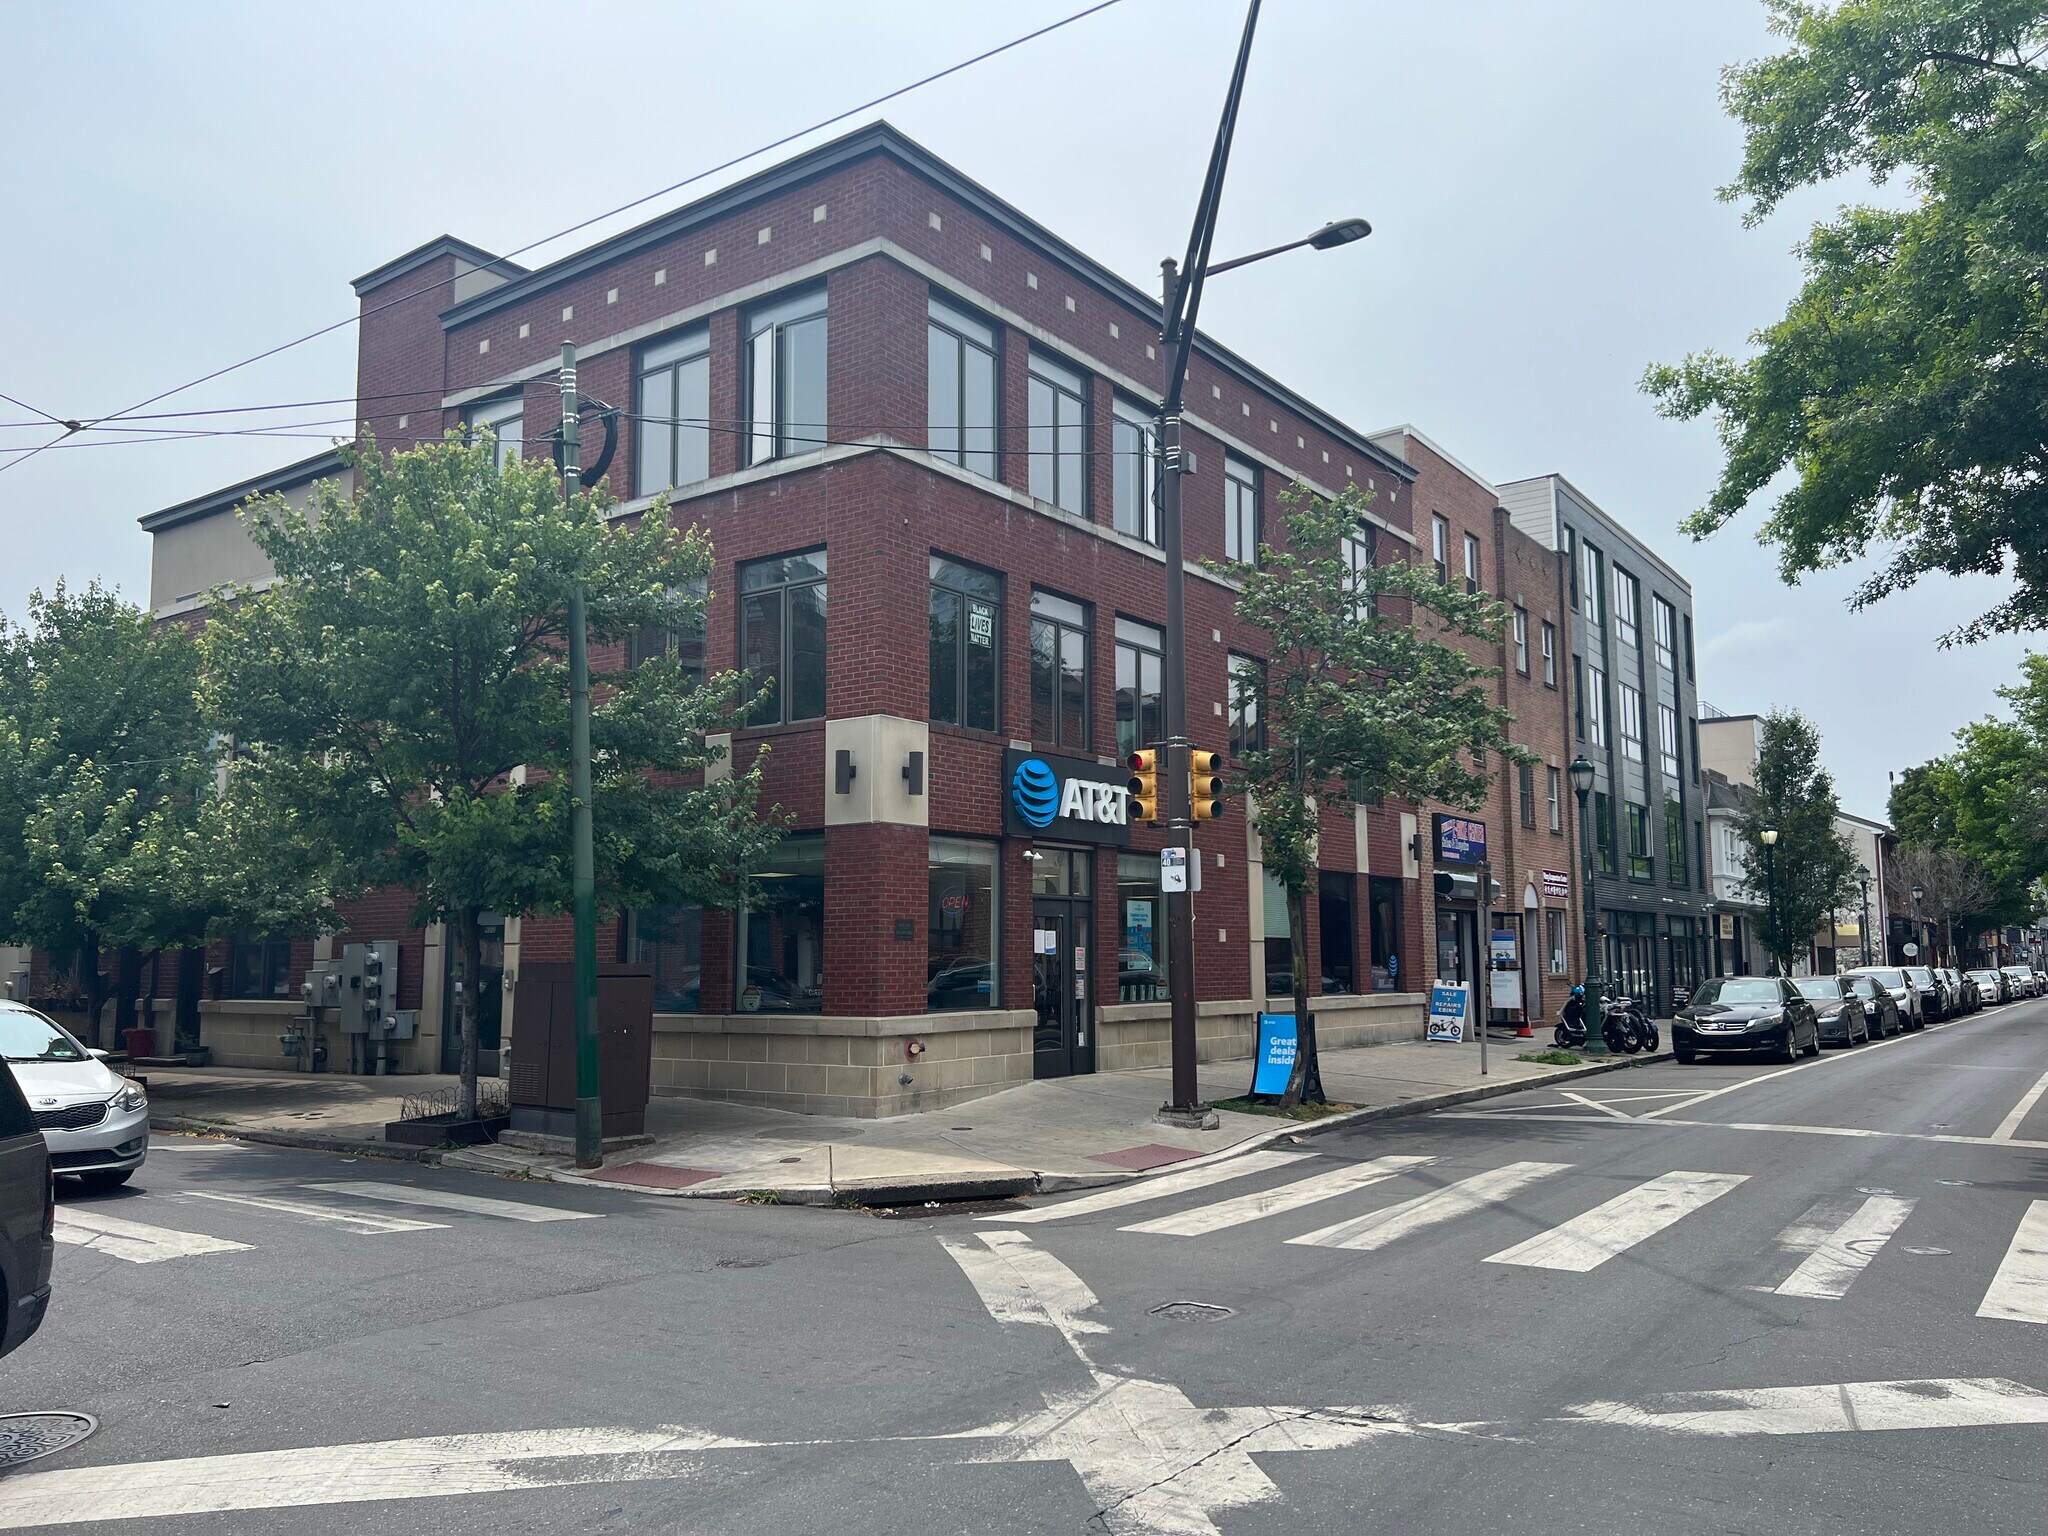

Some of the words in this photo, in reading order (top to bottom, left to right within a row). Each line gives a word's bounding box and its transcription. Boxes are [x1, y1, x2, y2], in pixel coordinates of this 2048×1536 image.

[972, 603, 989, 617] BLACK
[971, 616, 989, 633] LIVES
[970, 632, 990, 646] MATTER
[1059, 777, 1131, 826] AT&T
[1162, 858, 1171, 867] 40
[942, 896, 969, 910] OPEN
[1435, 1001, 1461, 1009] REPAIRS
[1270, 1036, 1297, 1046] Great
[1270, 1046, 1296, 1055] deals
